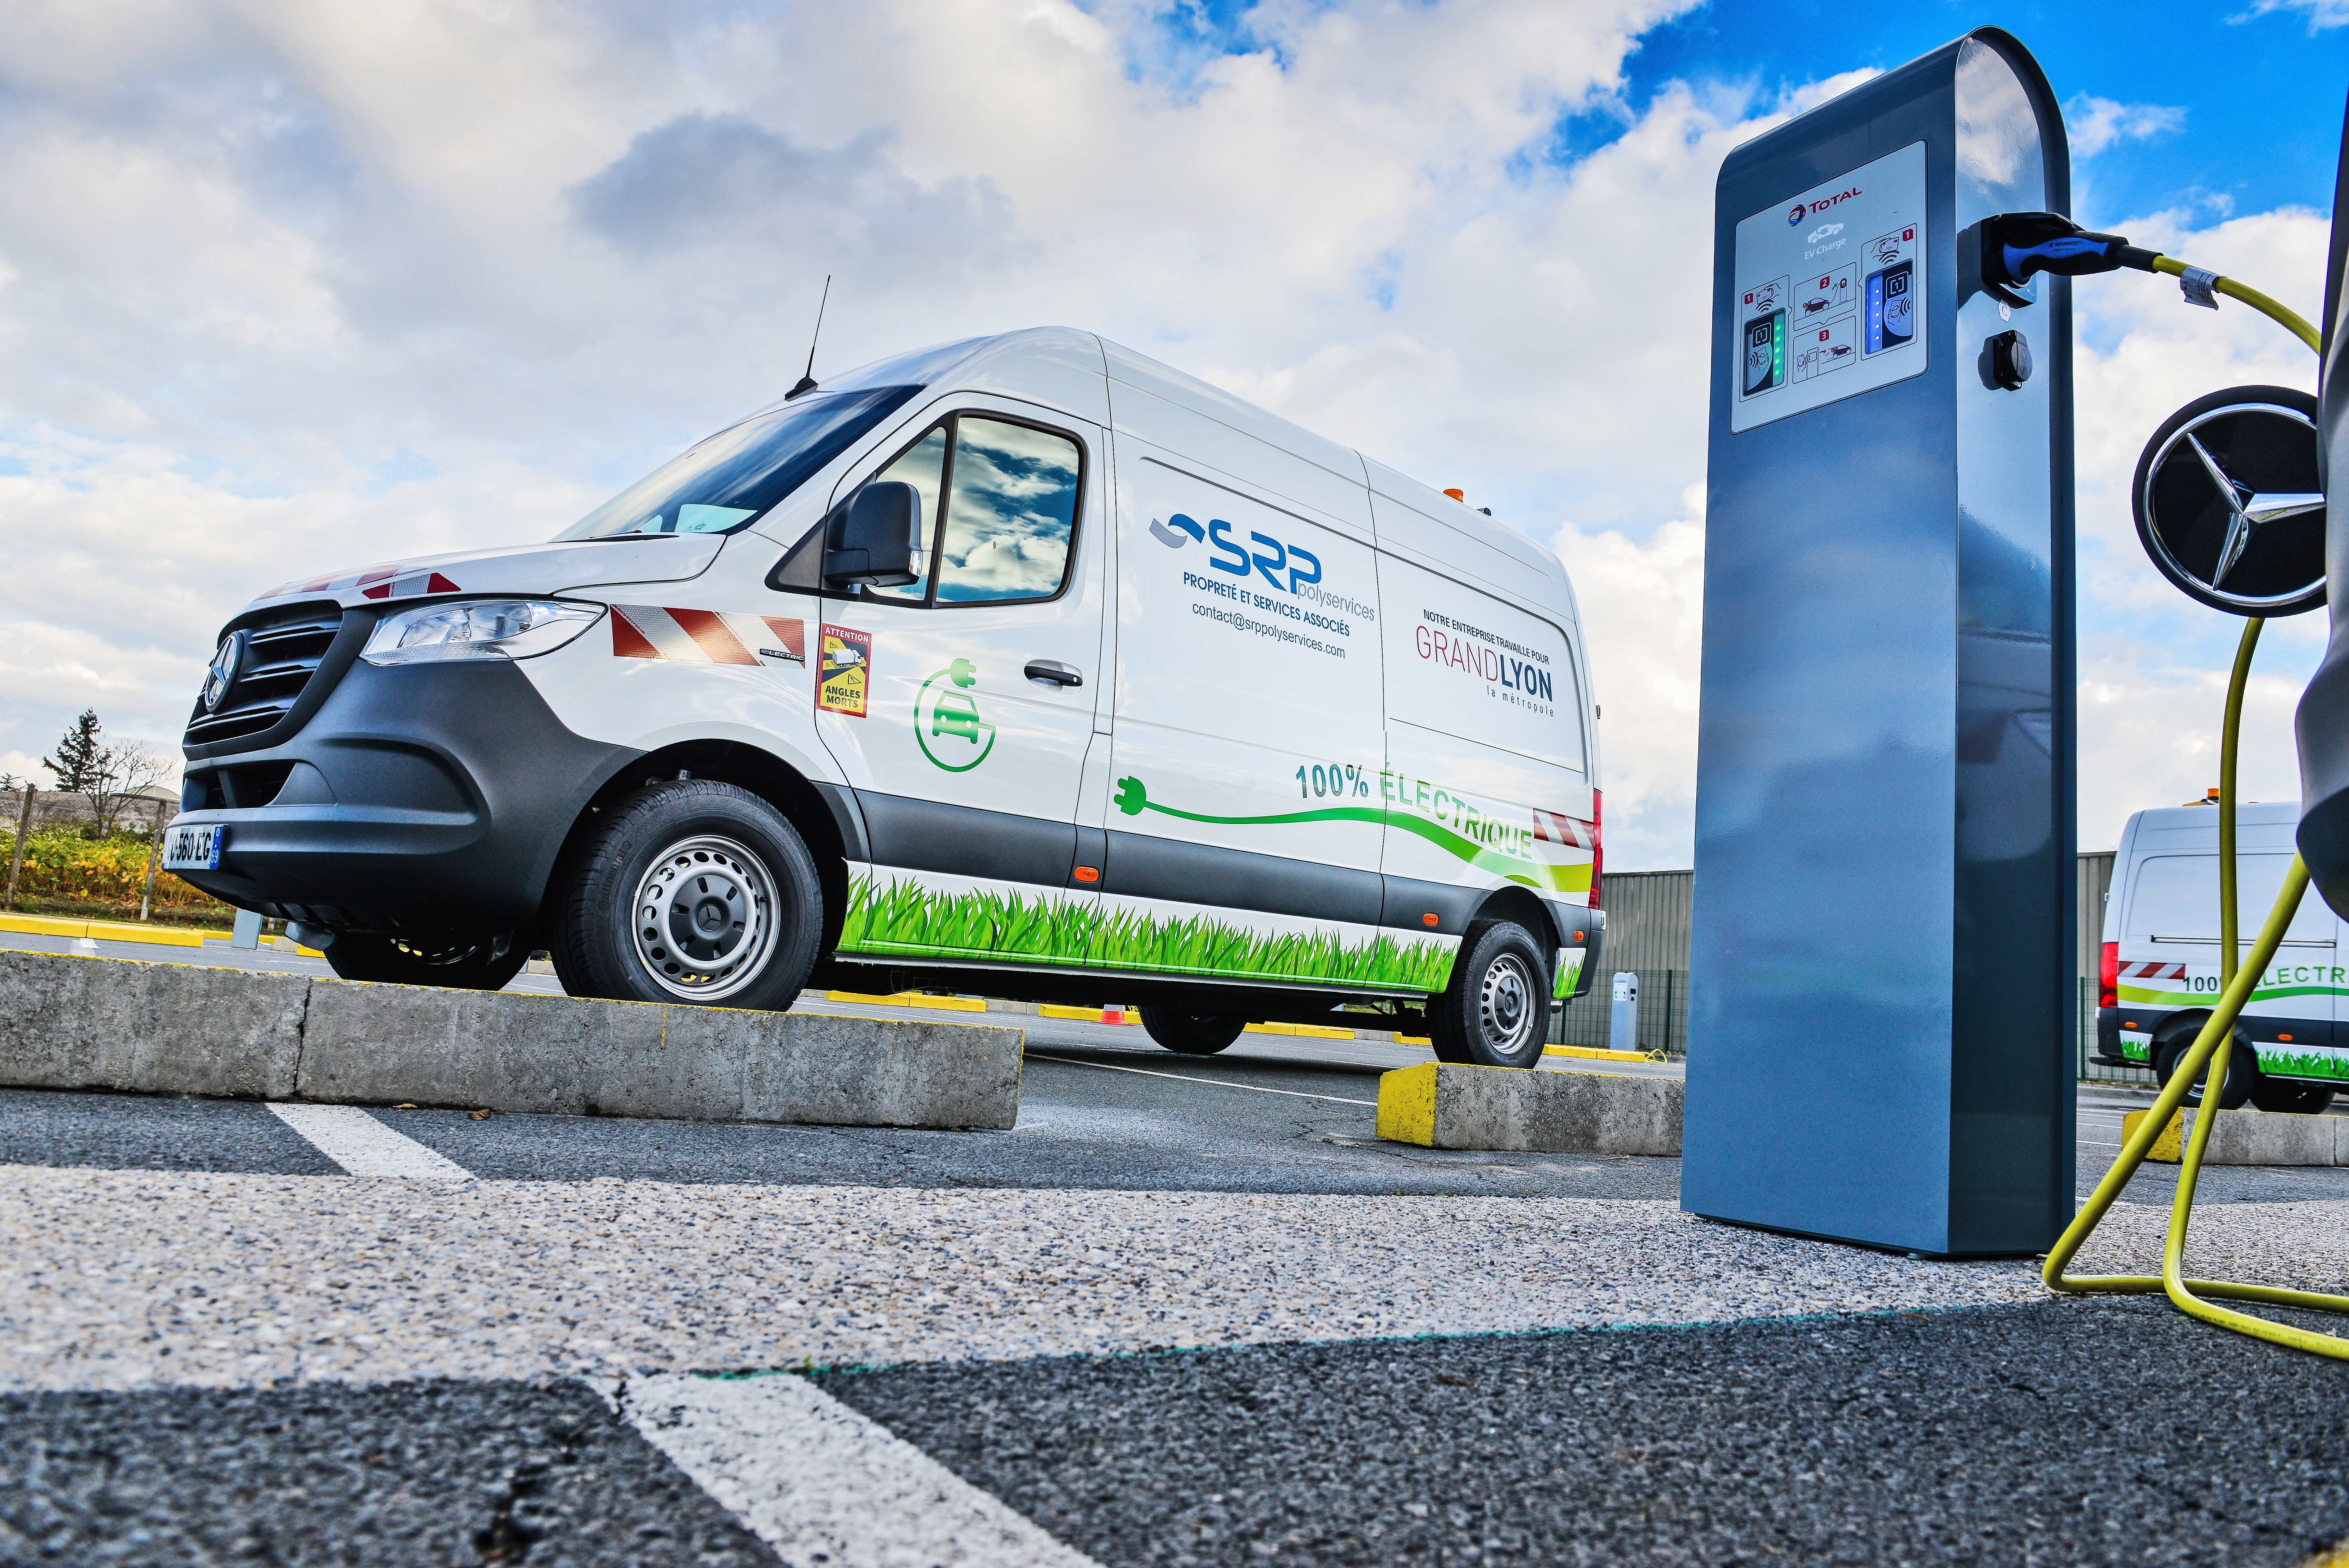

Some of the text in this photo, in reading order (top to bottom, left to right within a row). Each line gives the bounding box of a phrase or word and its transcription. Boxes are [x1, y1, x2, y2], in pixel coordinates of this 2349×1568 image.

[1809, 188, 1862, 213] TOTAL
[1804, 238, 1846, 259] EV Charge
[2002, 306, 2007, 316] C
[1208, 519, 1321, 595] SRP
[1184, 572, 1350, 637] PROPRETÉ ET SERVICES ASSOCIÉS
[1297, 582, 1374, 621] polyservices
[825, 627, 869, 643] ATTENTION
[1192, 603, 1345, 658] contact@srppolyservices.com
[1423, 609, 1549, 665] NOTRE ENTREPRISE TRAVAILLE POUR
[825, 685, 860, 699] ANGLES
[827, 695, 858, 708] MORTS
[1487, 685, 1553, 717] la métropole
[1296, 762, 1532, 860] 100% ÉLECTRIQUE
[211, 850, 218, 863] 69
[2183, 966, 2349, 991] 100 LECTR
